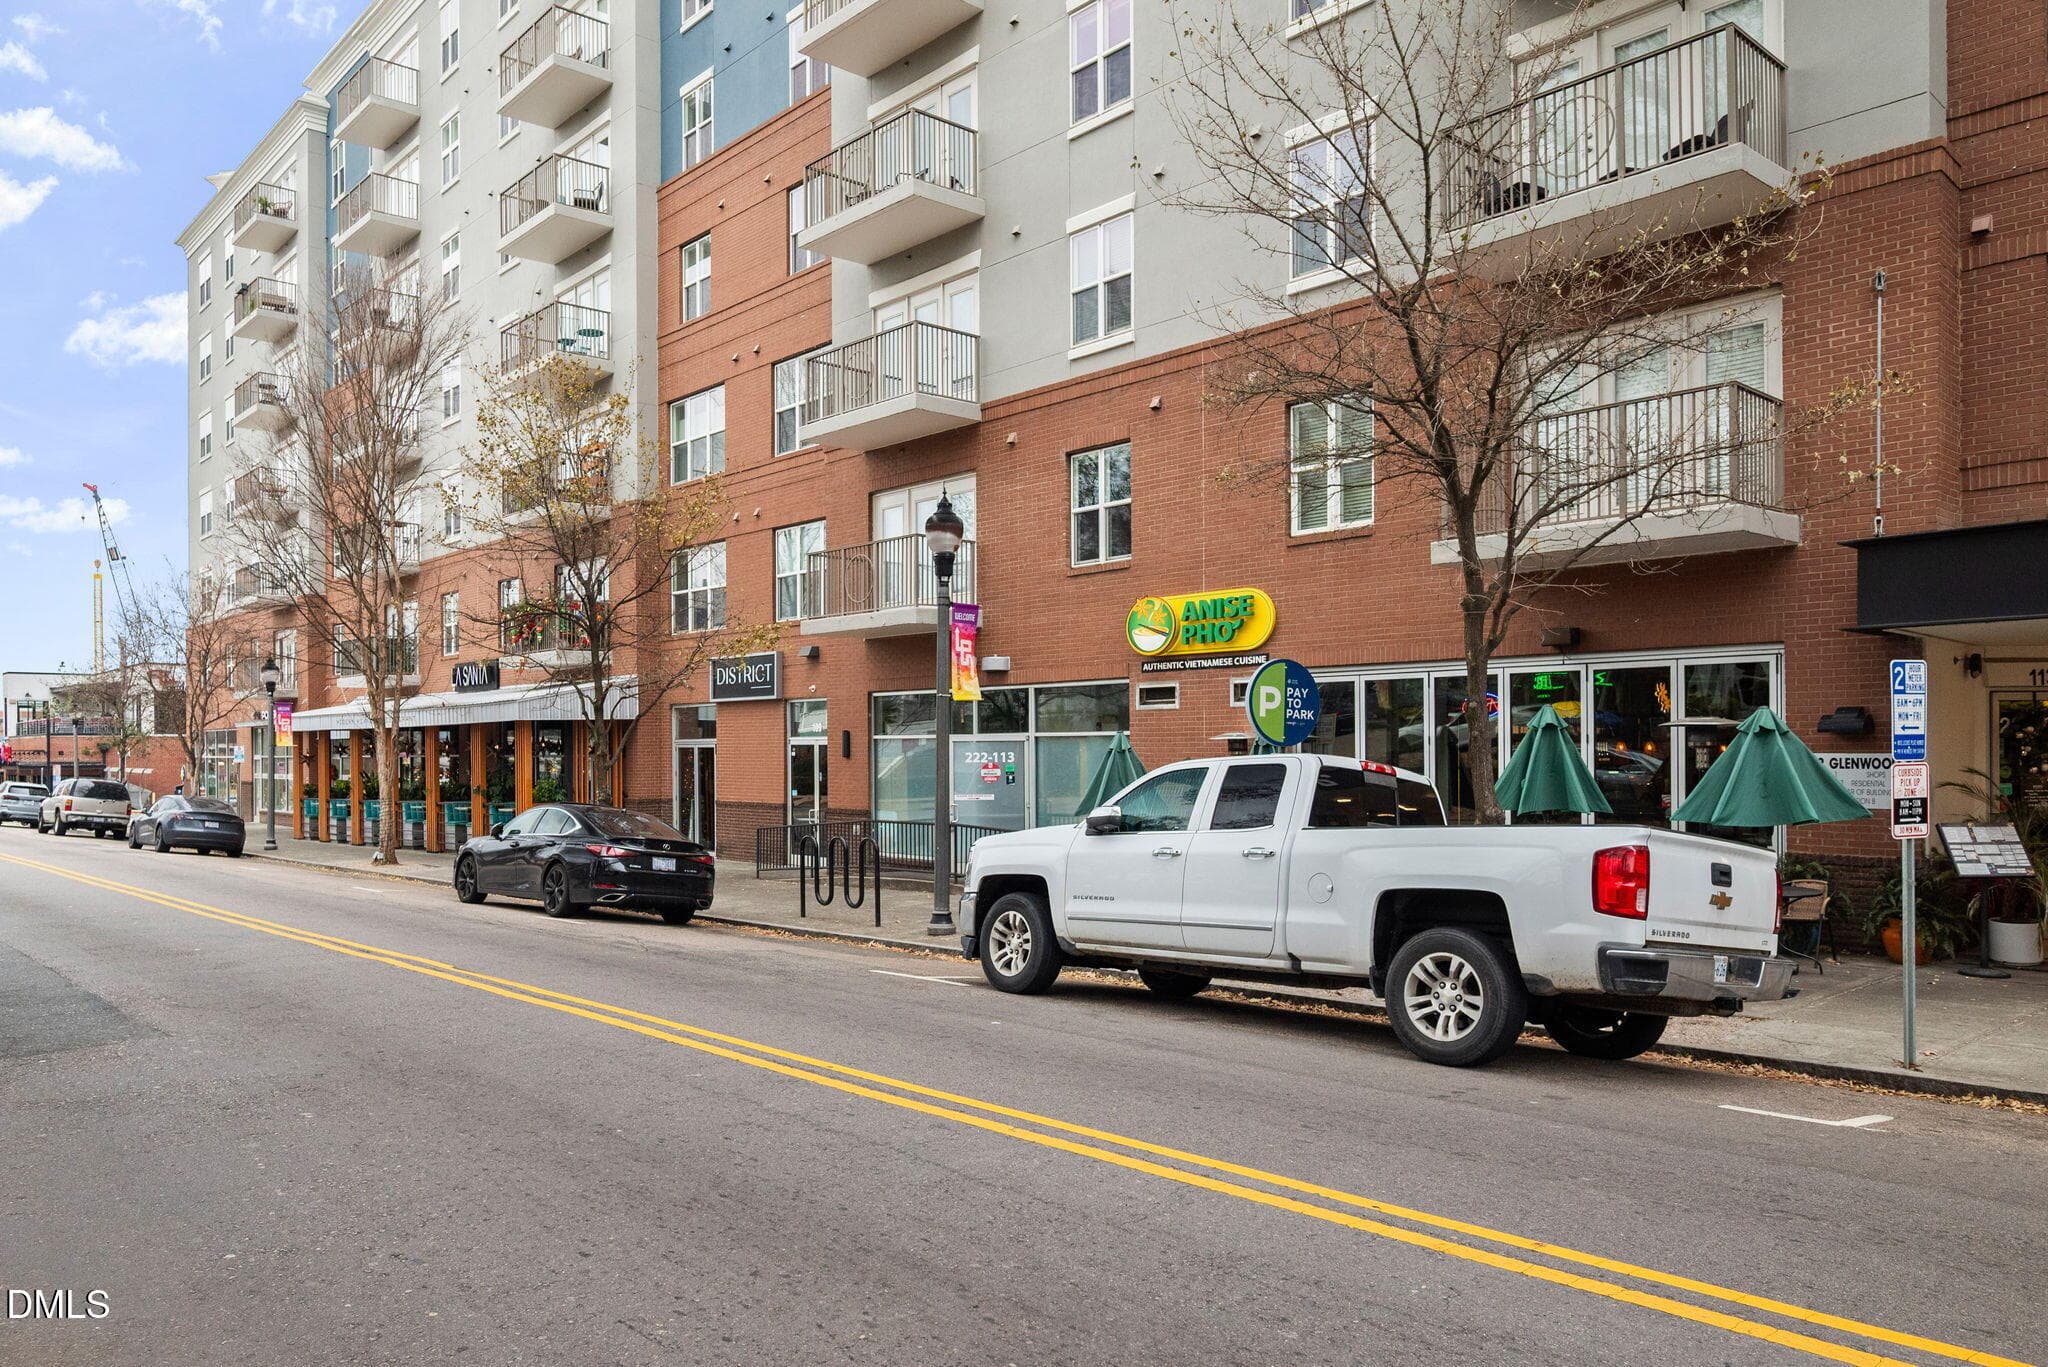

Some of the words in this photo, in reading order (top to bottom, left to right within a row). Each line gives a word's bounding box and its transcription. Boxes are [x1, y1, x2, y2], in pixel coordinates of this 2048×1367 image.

[1181, 595, 1254, 621] ANISE
[954, 612, 976, 622] WELCOME
[1142, 661, 1184, 672] AUTHENTIC
[1185, 658, 1233, 669] VIETNAMESE
[1234, 655, 1267, 666] CUISINE
[1909, 664, 1921, 673] HOUR
[716, 663, 772, 685] DISTRICT
[1894, 666, 1904, 690] 2
[1908, 673, 1922, 682] METER
[2029, 668, 2048, 686] 11
[1906, 683, 1925, 691] PARKING
[1286, 687, 1309, 698] PAY
[1260, 686, 1281, 717] P
[1286, 698, 1302, 708] TO
[1286, 709, 1314, 720] PARK
[965, 751, 1015, 763] 222-113
[1829, 757, 1893, 770] GLENWOO
[1898, 768, 1922, 777] CURBSIDE
[1851, 780, 1886, 788] RESIDENTIAL
[1900, 778, 1912, 787] PICK
[1913, 777, 1921, 786] UP
[1904, 788, 1917, 796] ZONE
[1651, 929, 1690, 939] SILVERADO
